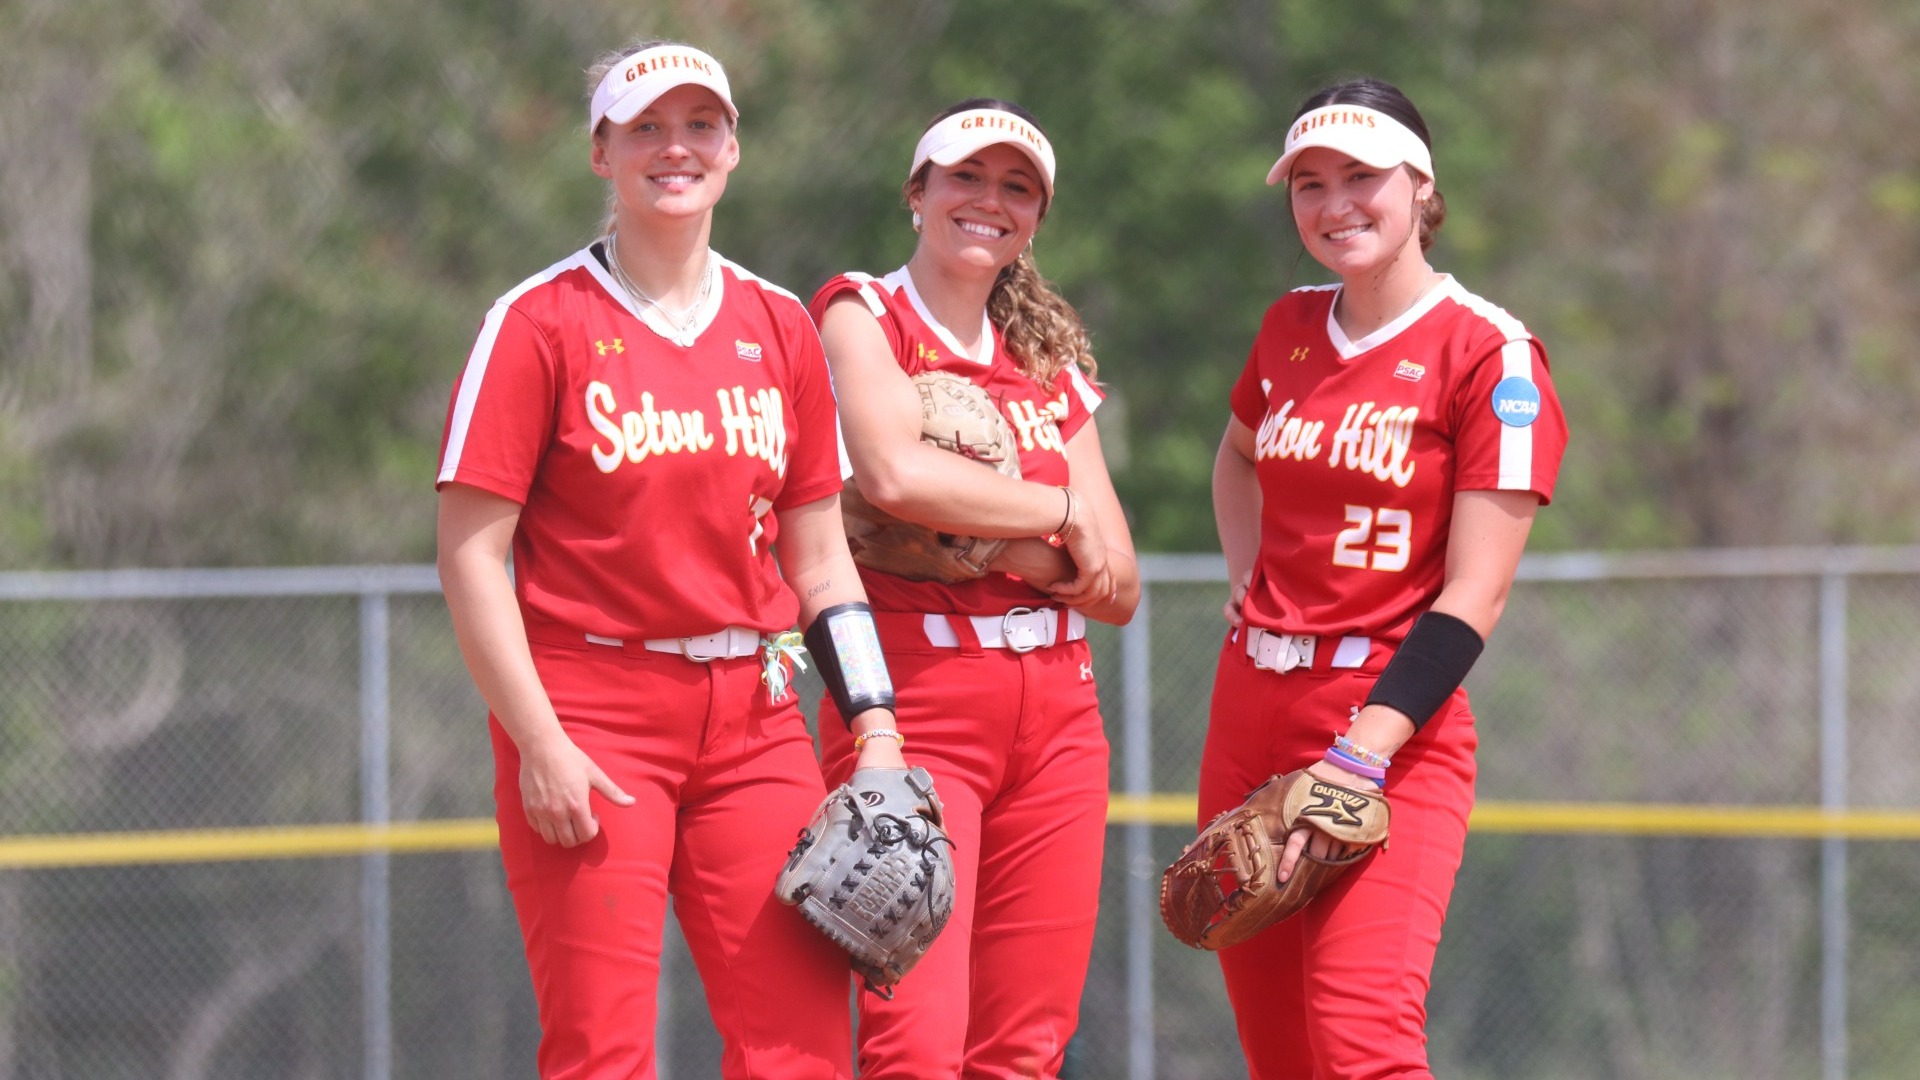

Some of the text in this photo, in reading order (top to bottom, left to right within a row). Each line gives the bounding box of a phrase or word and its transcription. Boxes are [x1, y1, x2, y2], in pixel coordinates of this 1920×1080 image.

[625, 55, 712, 82] GRIFFINS
[961, 116, 1043, 151] GRIFFINS
[1293, 111, 1376, 141] GRIFFINS
[1397, 365, 1423, 377] PSAC
[1498, 399, 1538, 416] NCAA
[585, 380, 787, 480] Seton Hill
[1255, 378, 1420, 488] eton Hill
[1332, 504, 1413, 572] 23
[1313, 784, 1367, 808] MIZUNO
